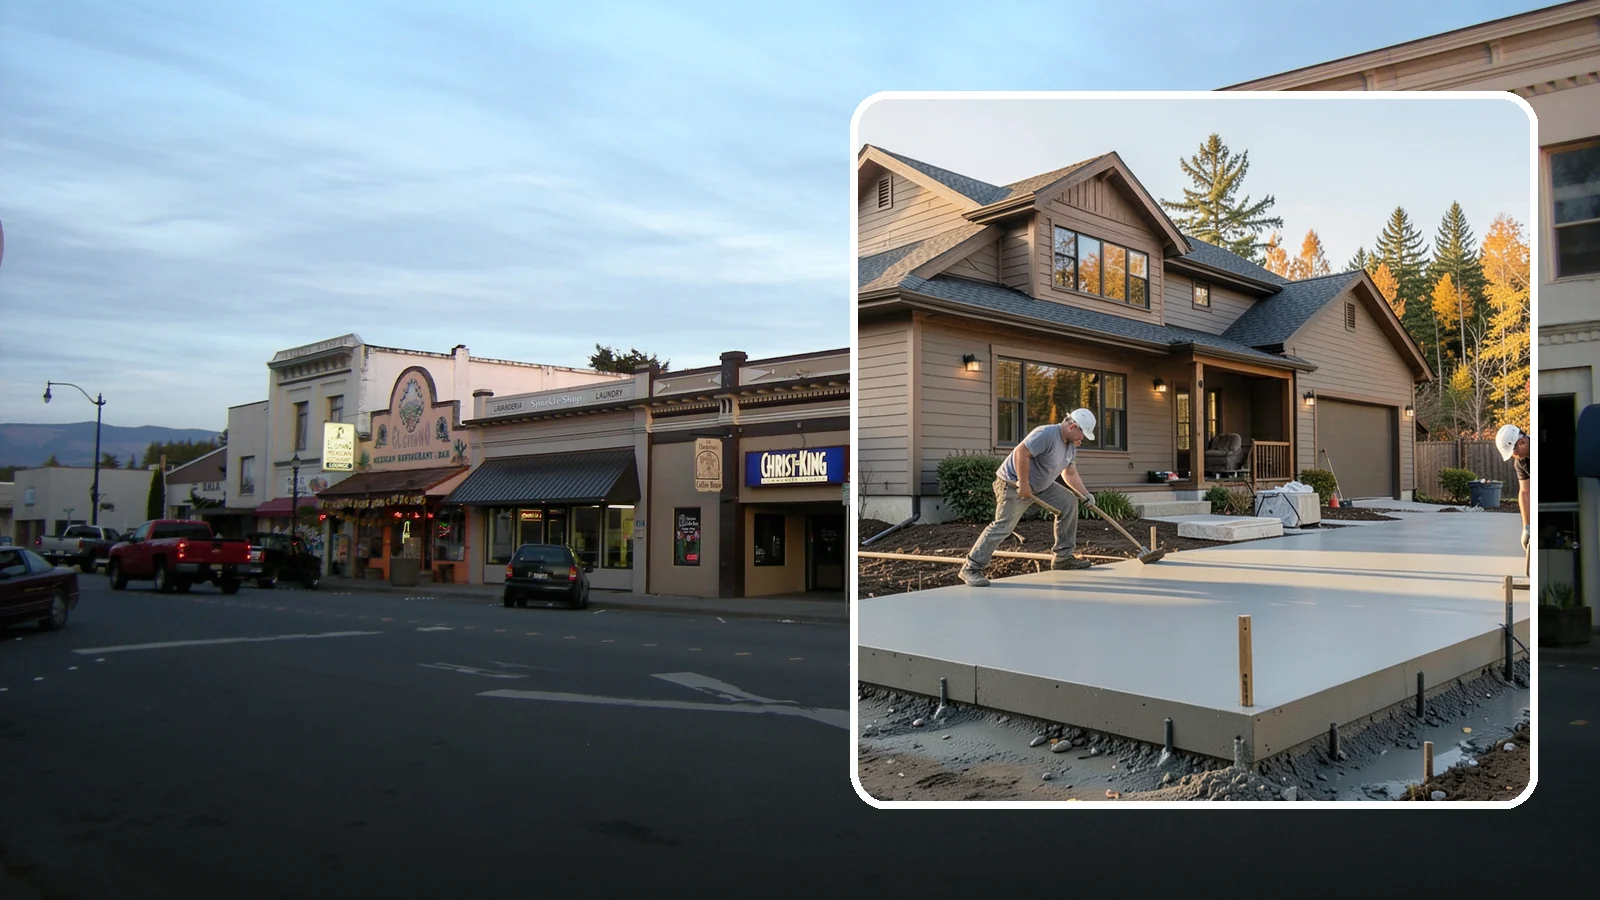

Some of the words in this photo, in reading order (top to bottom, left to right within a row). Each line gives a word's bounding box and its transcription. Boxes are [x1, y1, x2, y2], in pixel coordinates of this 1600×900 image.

[595, 389, 623, 400] LAUNDRY
[493, 402, 522, 412] LAVANDERIA
[531, 397, 560, 408] Sparkle
[562, 395, 582, 404] Shop
[374, 454, 396, 464] MEXICAN
[398, 451, 433, 462] RESTAURANT
[438, 450, 450, 459] BAR
[760, 452, 797, 478] CHRIST
[799, 450, 827, 476] KING
